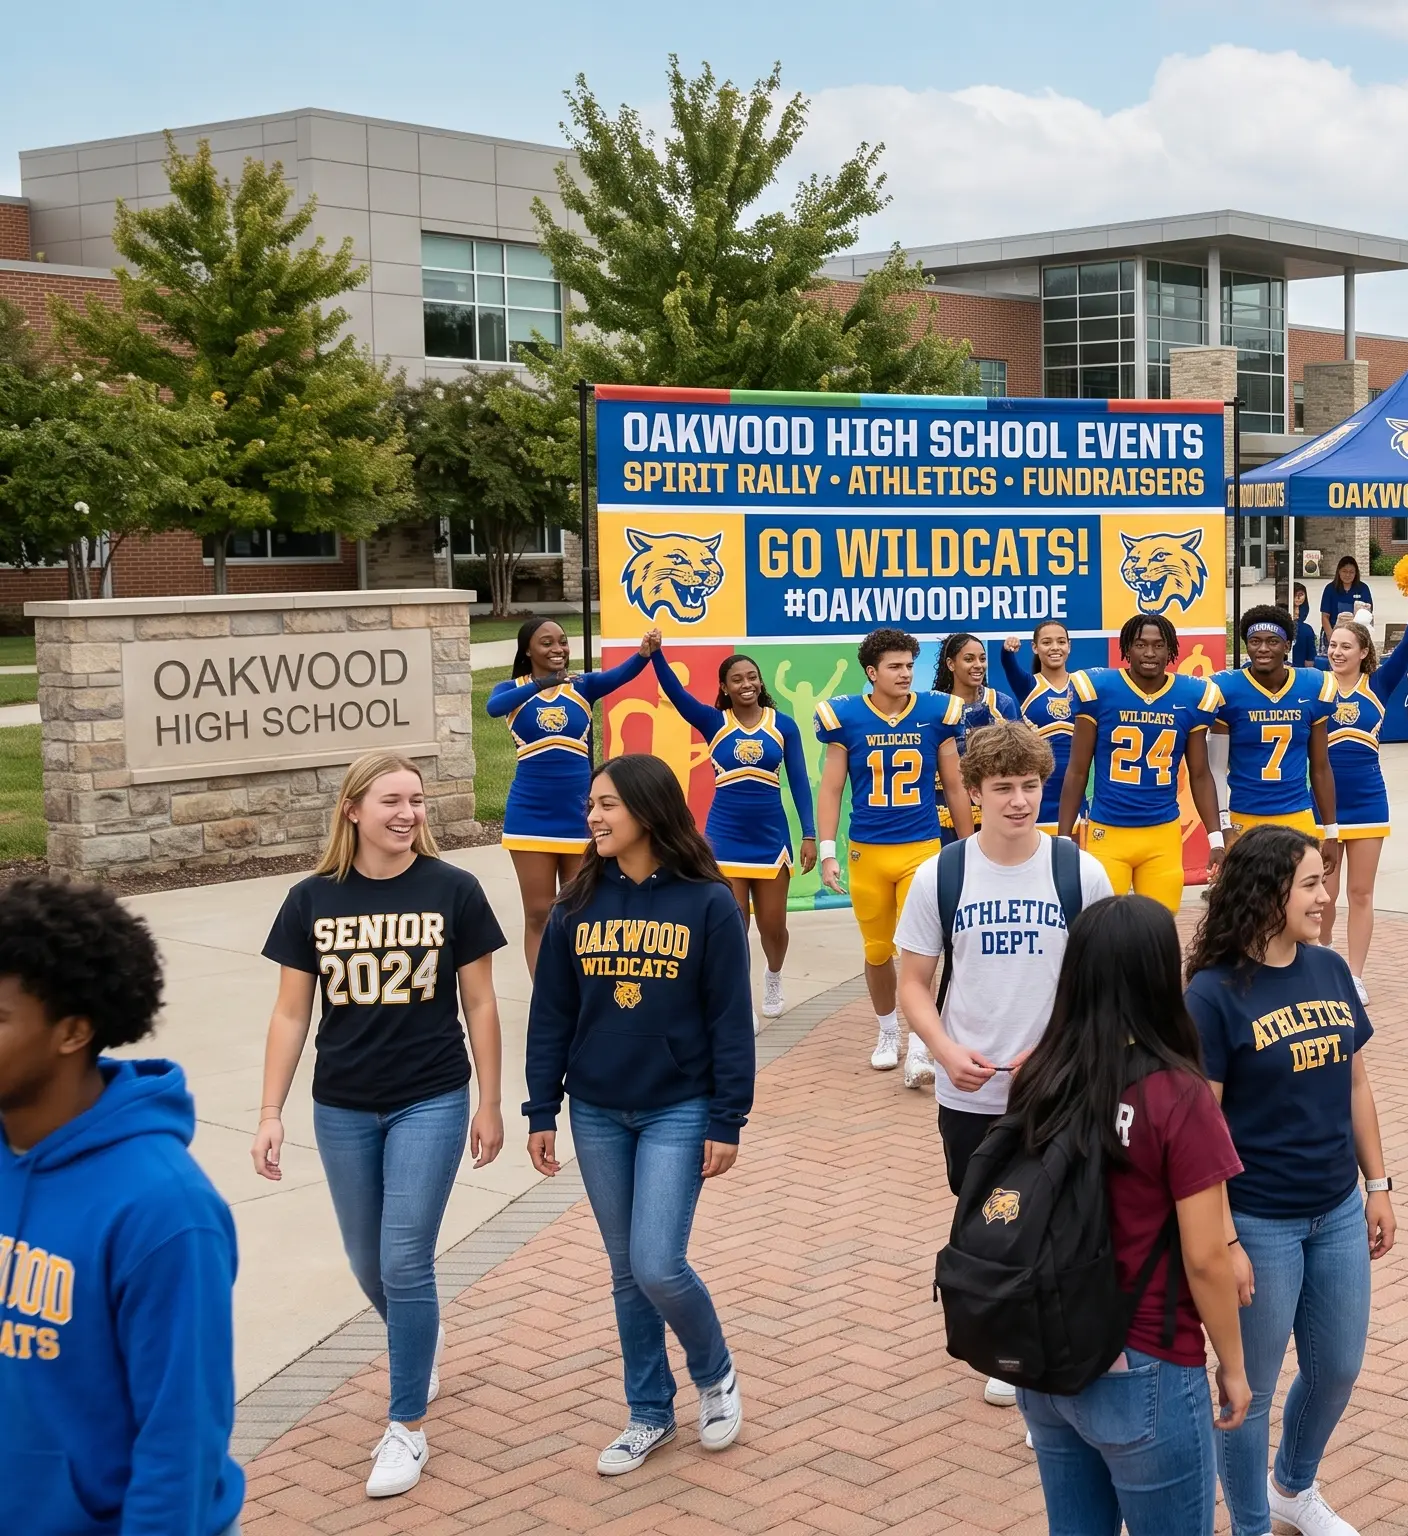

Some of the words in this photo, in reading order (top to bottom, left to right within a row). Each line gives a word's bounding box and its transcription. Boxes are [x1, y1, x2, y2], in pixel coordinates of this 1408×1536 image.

[623, 412, 814, 456] OAKWOOD
[827, 417, 917, 459] HIGH
[929, 419, 1066, 461] SCHOOL
[1077, 421, 1204, 461] EVENTS
[623, 461, 729, 494] SPIRIT
[737, 463, 821, 495] RALLY
[847, 465, 997, 496] ATHLETICS
[1023, 467, 1204, 497] FUNDRAISERS
[759, 528, 822, 578] GO
[836, 528, 1090, 579] WILDCATS!
[784, 584, 1068, 623] #OAKWOODPRIDE
[153, 649, 408, 700] OAKWOOD
[156, 709, 249, 746] HIGH
[262, 698, 410, 737] SCHOOL
[1119, 710, 1175, 726] WILDCATS
[1248, 709, 1302, 722] WILDCATS
[866, 733, 921, 746] WILDCATS
[1110, 725, 1178, 786] 24
[1261, 724, 1293, 781] 7
[866, 748, 923, 807] 12
[314, 912, 445, 953] SENIOR
[575, 920, 690, 960] OAKWOOD
[981, 931, 1043, 955] DEPT.
[320, 949, 439, 1006] 2024
[581, 957, 680, 979] WILDCATS
[1251, 1000, 1355, 1051] ATHLETICS
[1289, 1034, 1348, 1073] DEPT.
